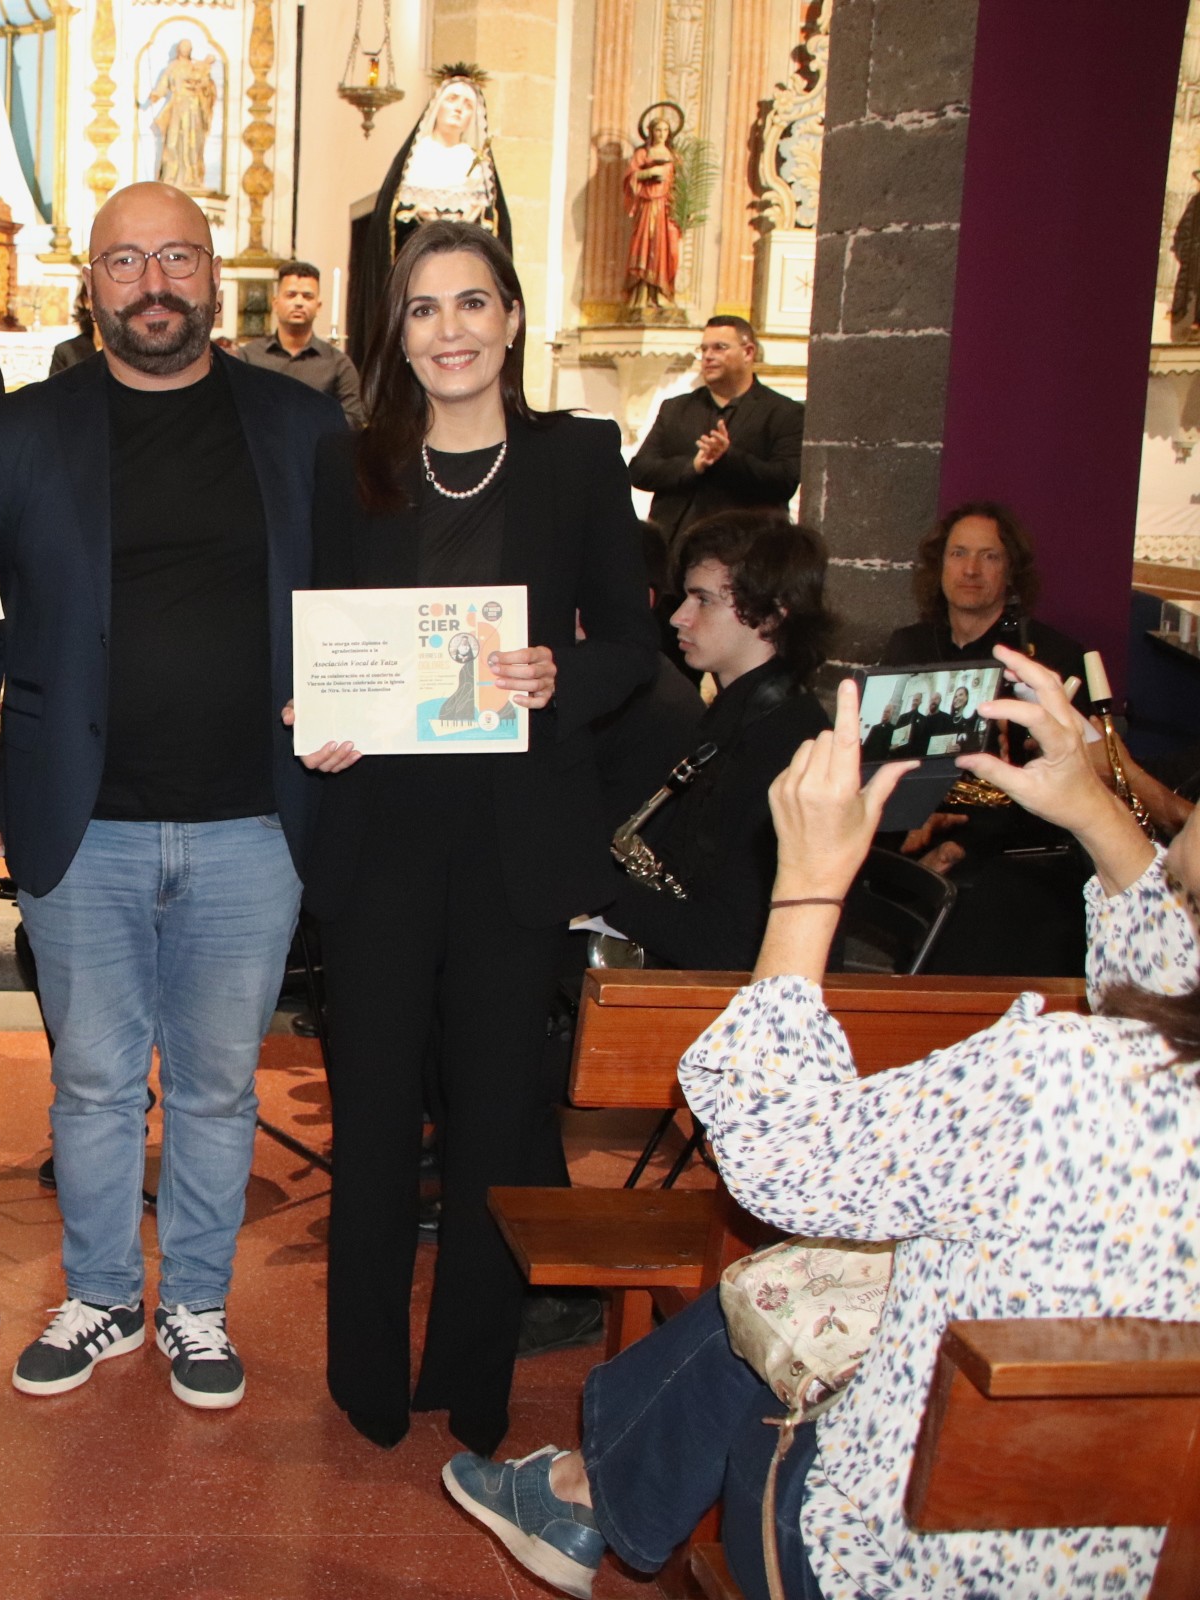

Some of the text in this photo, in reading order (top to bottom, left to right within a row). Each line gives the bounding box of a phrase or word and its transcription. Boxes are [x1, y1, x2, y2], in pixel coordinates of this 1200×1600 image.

[418, 603, 457, 617] CON
[419, 619, 460, 632] CIER
[419, 634, 443, 648] TO
